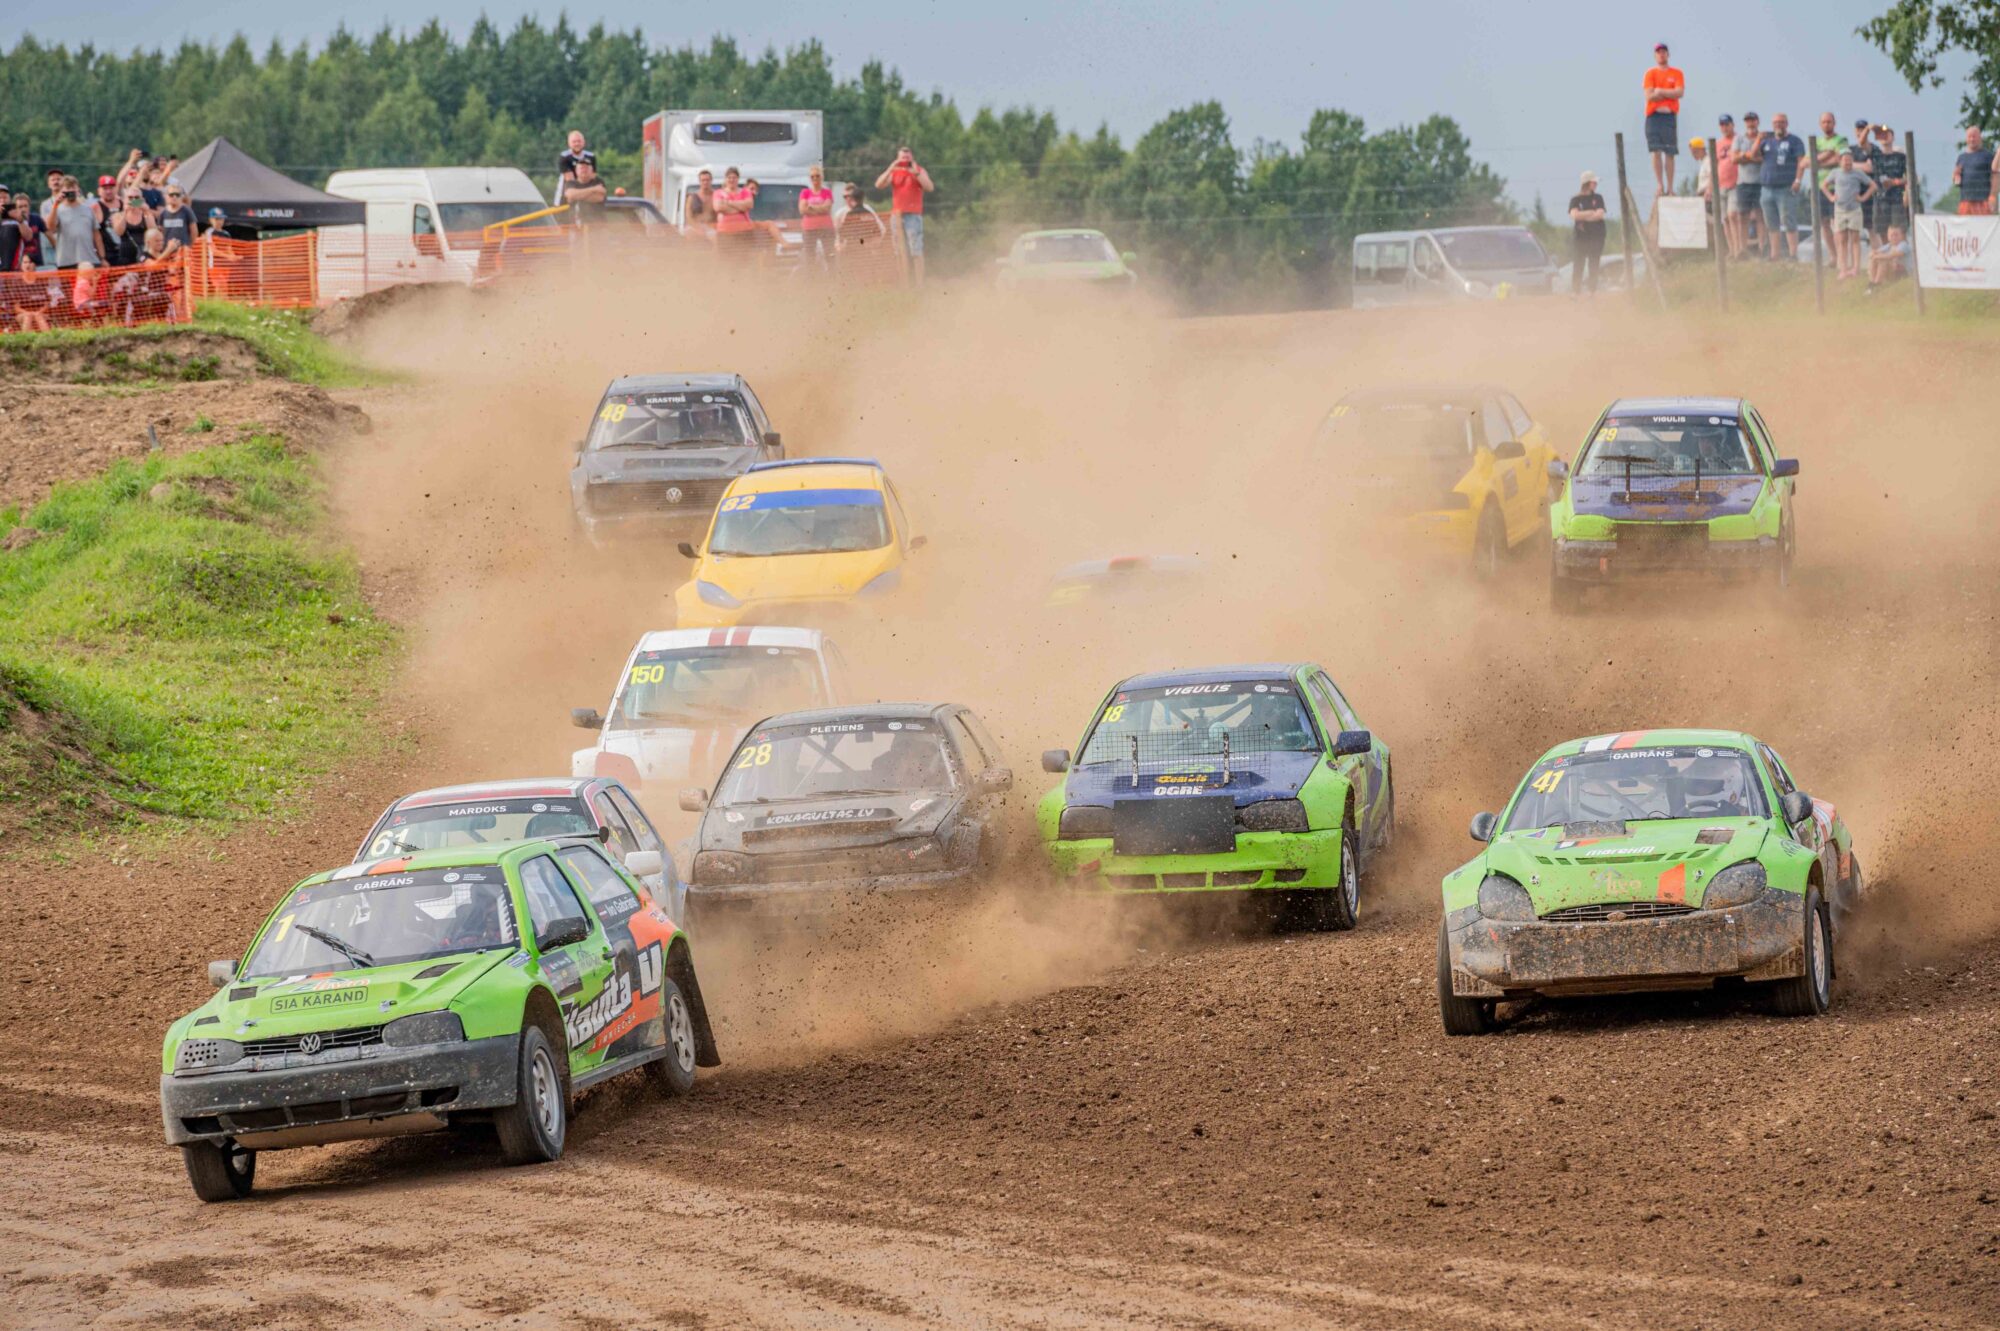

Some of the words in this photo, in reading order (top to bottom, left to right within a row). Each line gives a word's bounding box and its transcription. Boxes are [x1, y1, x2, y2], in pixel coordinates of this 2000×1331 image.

[600, 403, 627, 423] 48
[721, 495, 756, 512] 82
[630, 665, 665, 685] 150
[1164, 684, 1232, 697] VIGULIS
[1102, 705, 1126, 723] 18
[810, 723, 864, 734] PLETIENS
[737, 743, 773, 769] 28
[1153, 785, 1203, 796] OGRE
[1531, 770, 1565, 793] 41
[448, 805, 507, 816] MARDOKS
[766, 808, 876, 825] KOKAGULTAS.LV
[370, 827, 410, 858] 61
[353, 877, 414, 891] GABRĀNS
[275, 913, 296, 943] 1
[275, 999, 298, 1011] SIA
[302, 990, 364, 1007] KĀRAND
